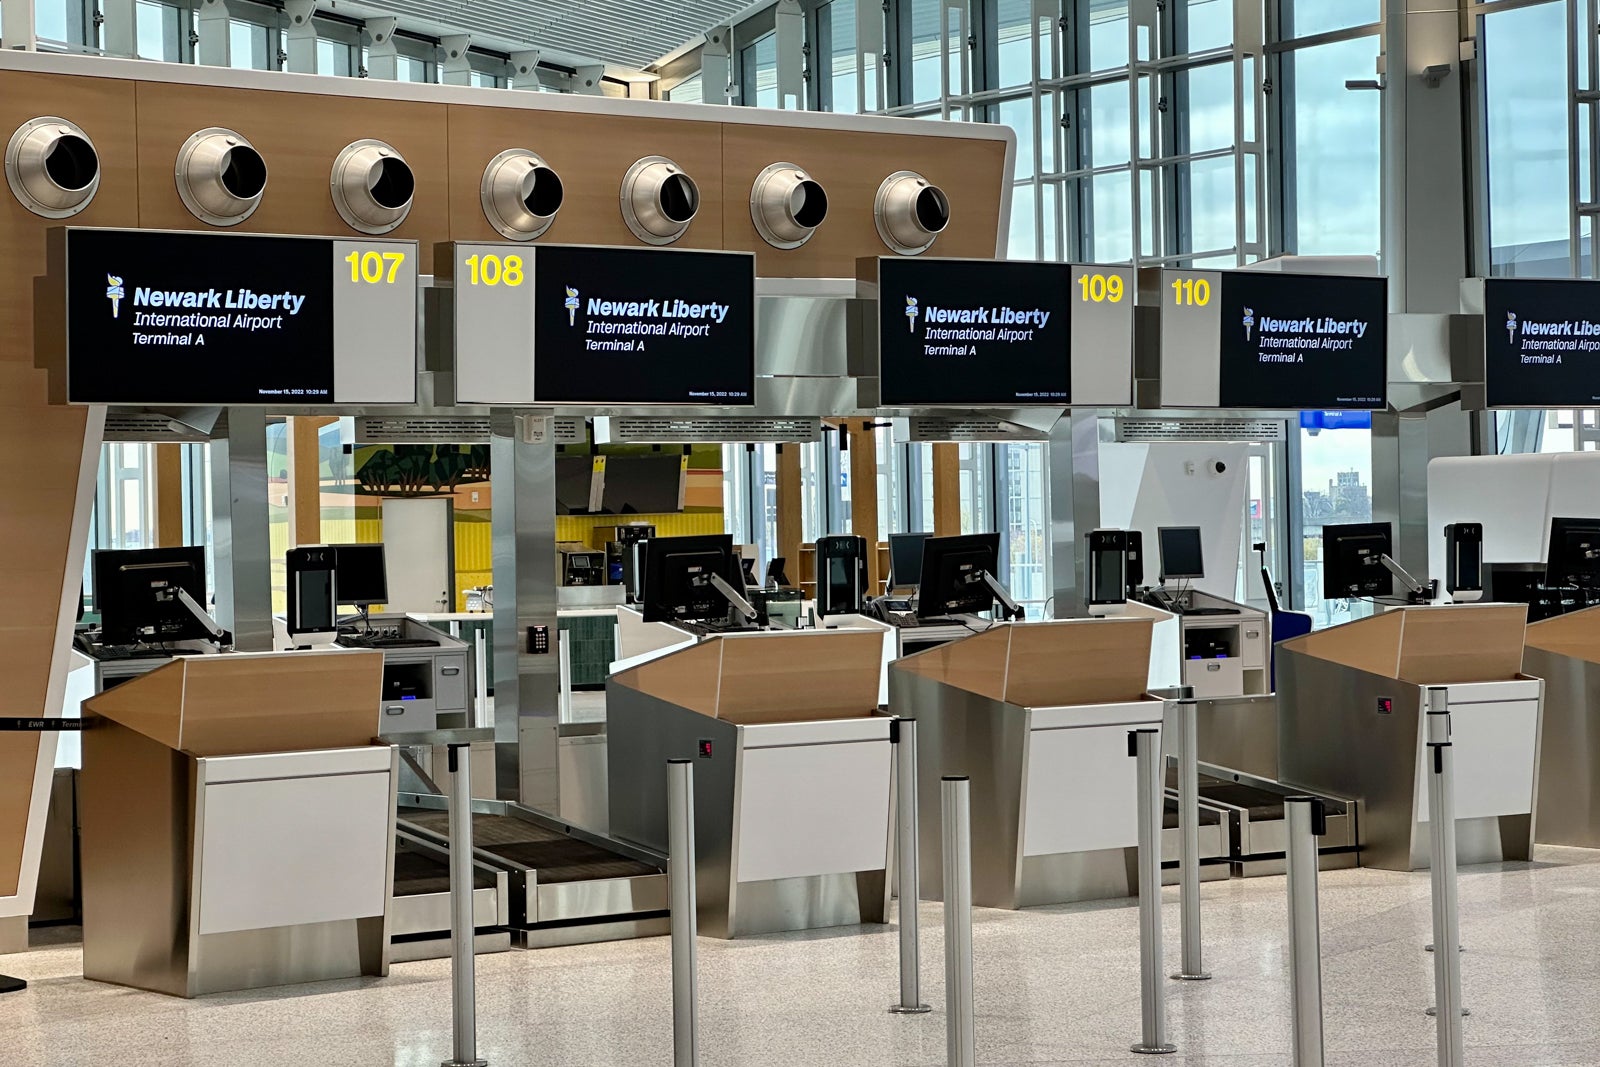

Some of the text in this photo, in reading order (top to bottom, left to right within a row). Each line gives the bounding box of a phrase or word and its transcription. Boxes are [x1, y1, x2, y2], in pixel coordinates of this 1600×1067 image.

[345, 251, 405, 284] 107
[465, 254, 524, 286] 108
[1078, 274, 1124, 303] 109
[1172, 278, 1211, 306] 110
[133, 287, 306, 315] Newark Liberty
[586, 298, 729, 324] Newark Liberty
[925, 306, 1050, 329] Newark Liberty
[133, 312, 283, 331] International Airport
[586, 320, 710, 338] International Airport
[1259, 316, 1367, 338] Newark Liberty
[1521, 320, 1571, 335] Newark
[132, 332, 205, 346] Terminal A
[924, 327, 1033, 343] International Airport
[1259, 336, 1353, 351] International Airport
[585, 339, 645, 352] Terminal A
[924, 344, 976, 356] Terminal A
[1521, 338, 1600, 352] International Airpo
[1258, 352, 1304, 363] Terminal A
[1520, 354, 1562, 364] Terminal A
